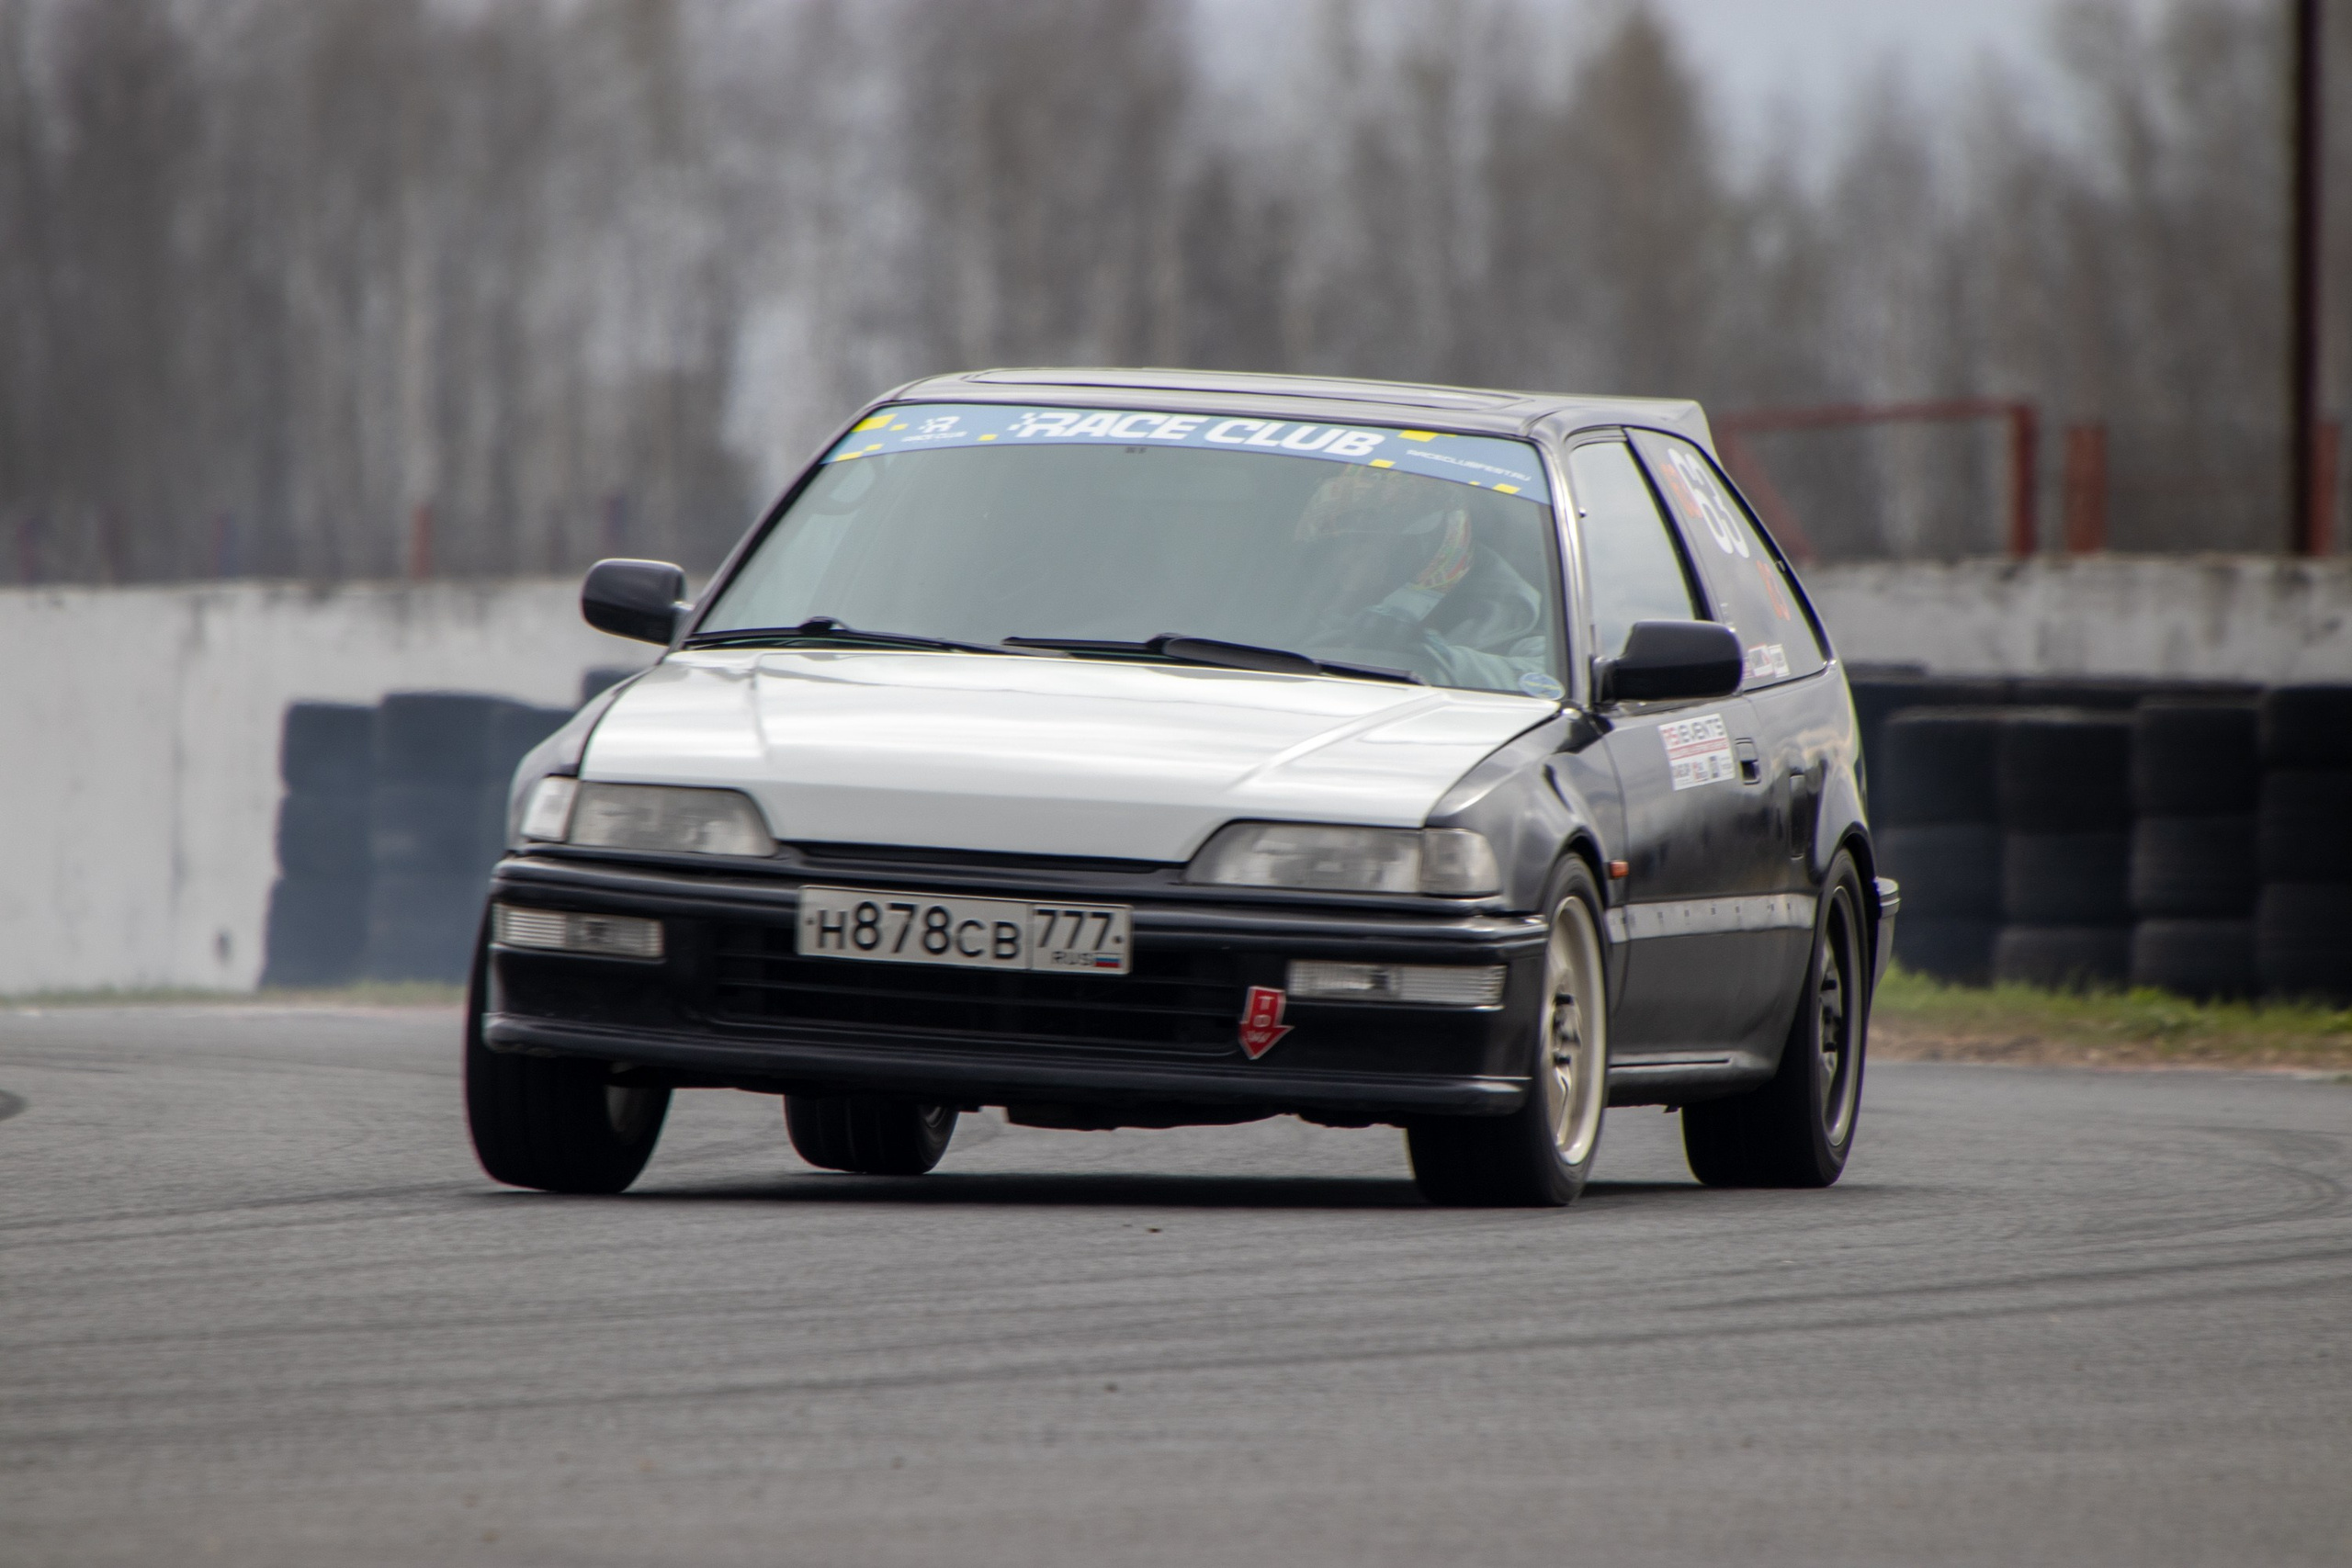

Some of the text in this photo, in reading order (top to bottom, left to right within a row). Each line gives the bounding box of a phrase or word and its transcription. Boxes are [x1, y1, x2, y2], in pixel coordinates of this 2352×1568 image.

[1008, 412, 1385, 457] RACE CLUB
[1668, 447, 1750, 559] 63
[1033, 908, 1114, 951] 777
[1051, 951, 1094, 965] RUS
